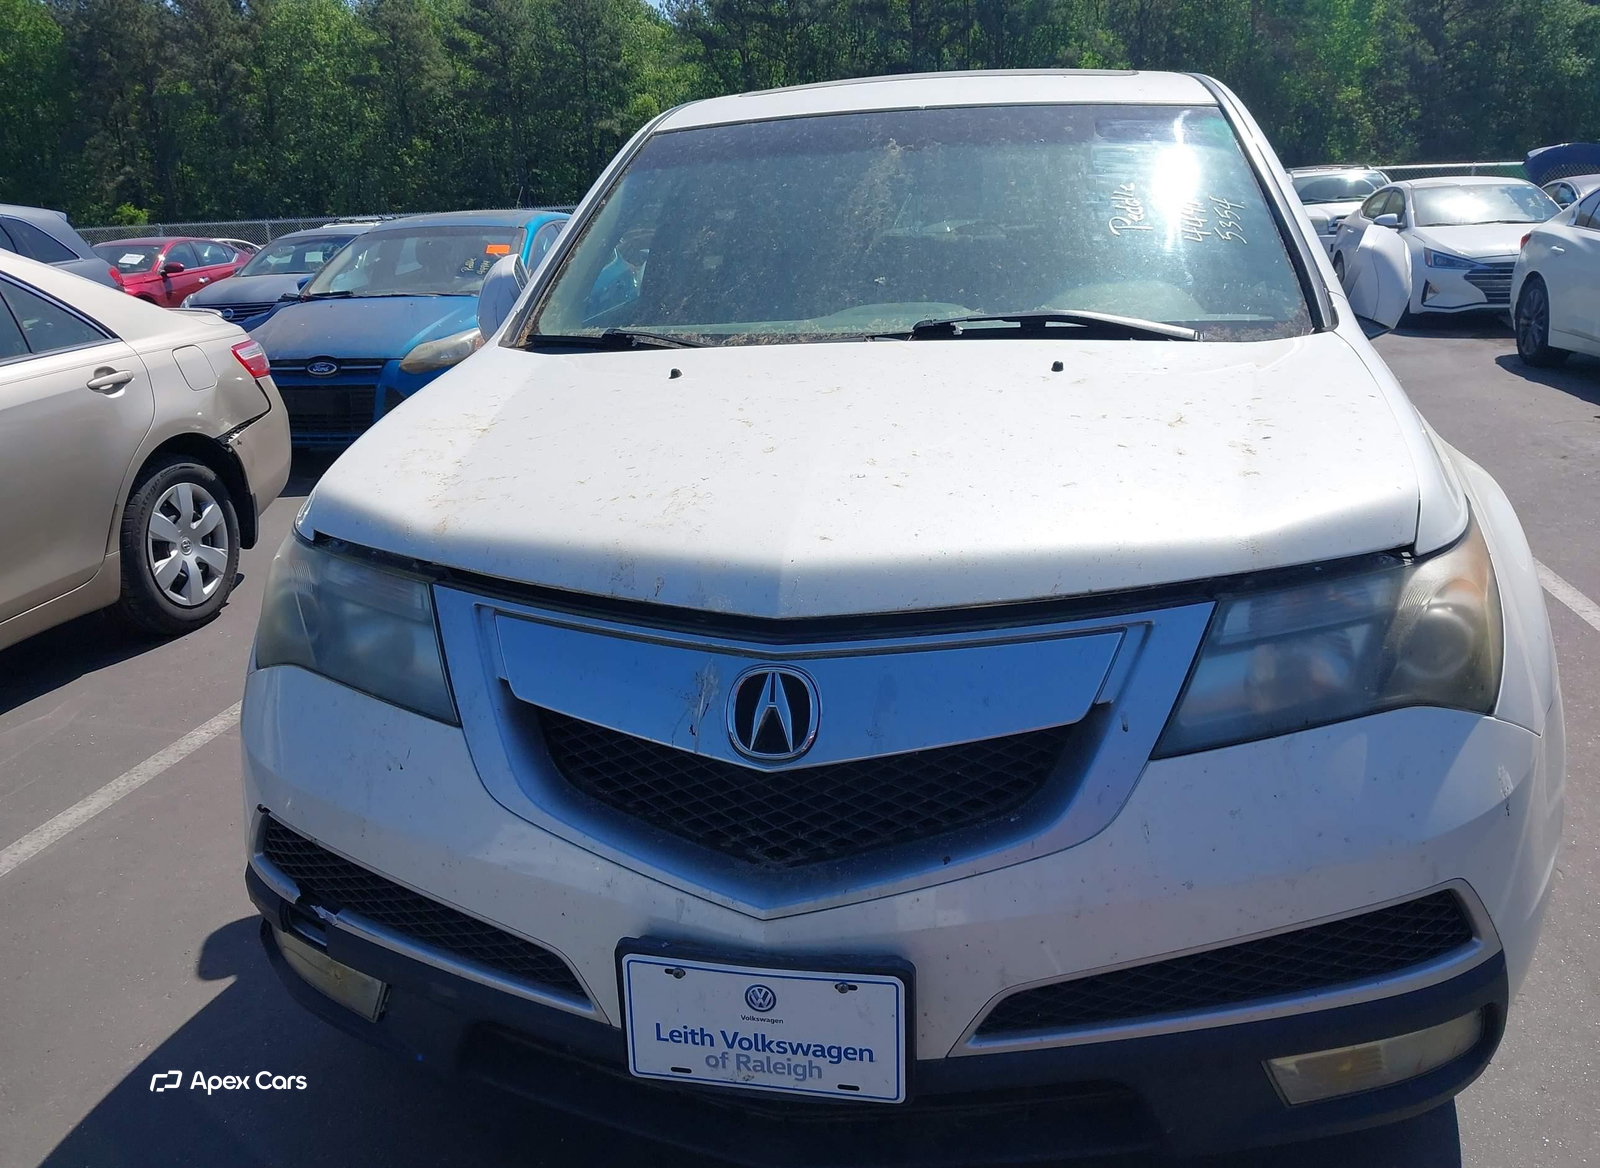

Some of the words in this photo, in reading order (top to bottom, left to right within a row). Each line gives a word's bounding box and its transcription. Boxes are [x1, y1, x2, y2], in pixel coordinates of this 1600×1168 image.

[1108, 182, 1154, 236] Peddle
[1208, 195, 1248, 245] 5354
[740, 1014, 784, 1025] Volkswagen
[655, 1022, 715, 1047] Leith
[720, 1029, 875, 1065] Volkswagen
[705, 1051, 729, 1069] of
[735, 1053, 823, 1082] Raleigh
